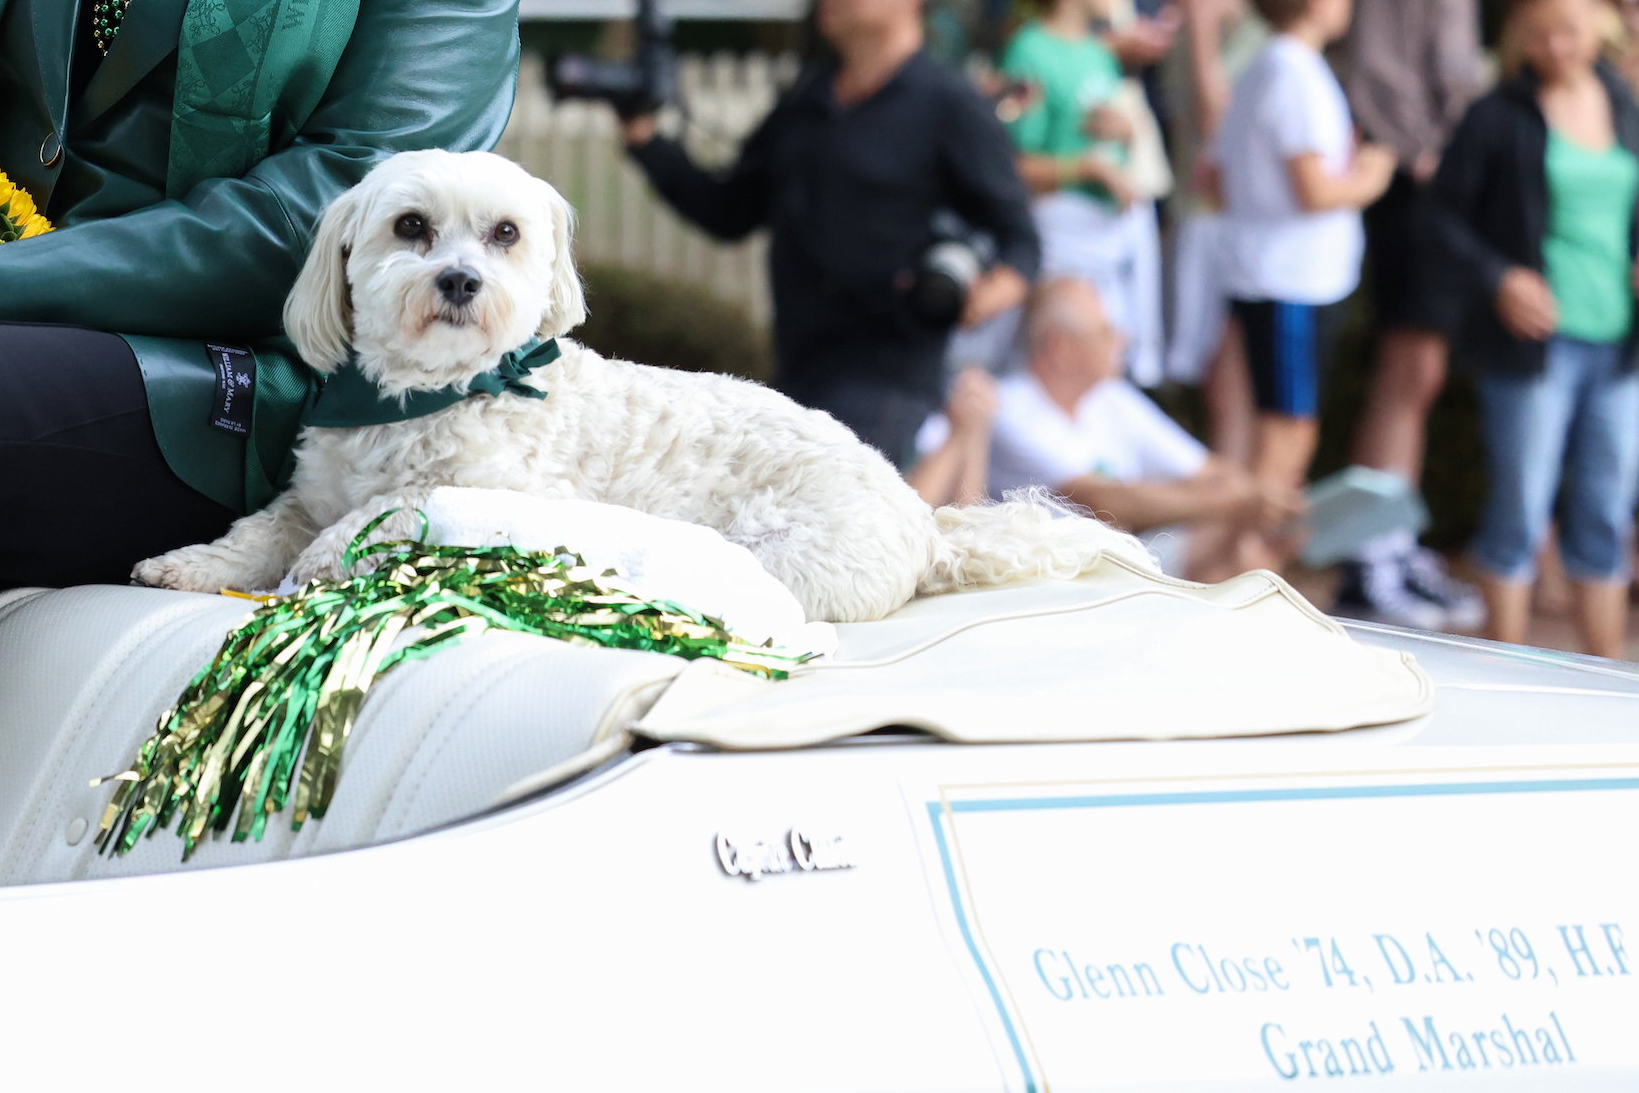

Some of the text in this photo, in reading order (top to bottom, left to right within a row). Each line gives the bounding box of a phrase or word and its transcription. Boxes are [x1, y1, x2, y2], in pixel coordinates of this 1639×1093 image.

[223, 387, 235, 414] MARY
[227, 378, 236, 388] &
[1033, 947, 1165, 1002] Glenn
[1170, 941, 1290, 995] Close
[1291, 936, 1374, 995] '74,
[1371, 931, 1475, 985] D.A.
[1474, 926, 1559, 988] '89,
[1259, 1010, 1577, 1081] Grand Marshal
